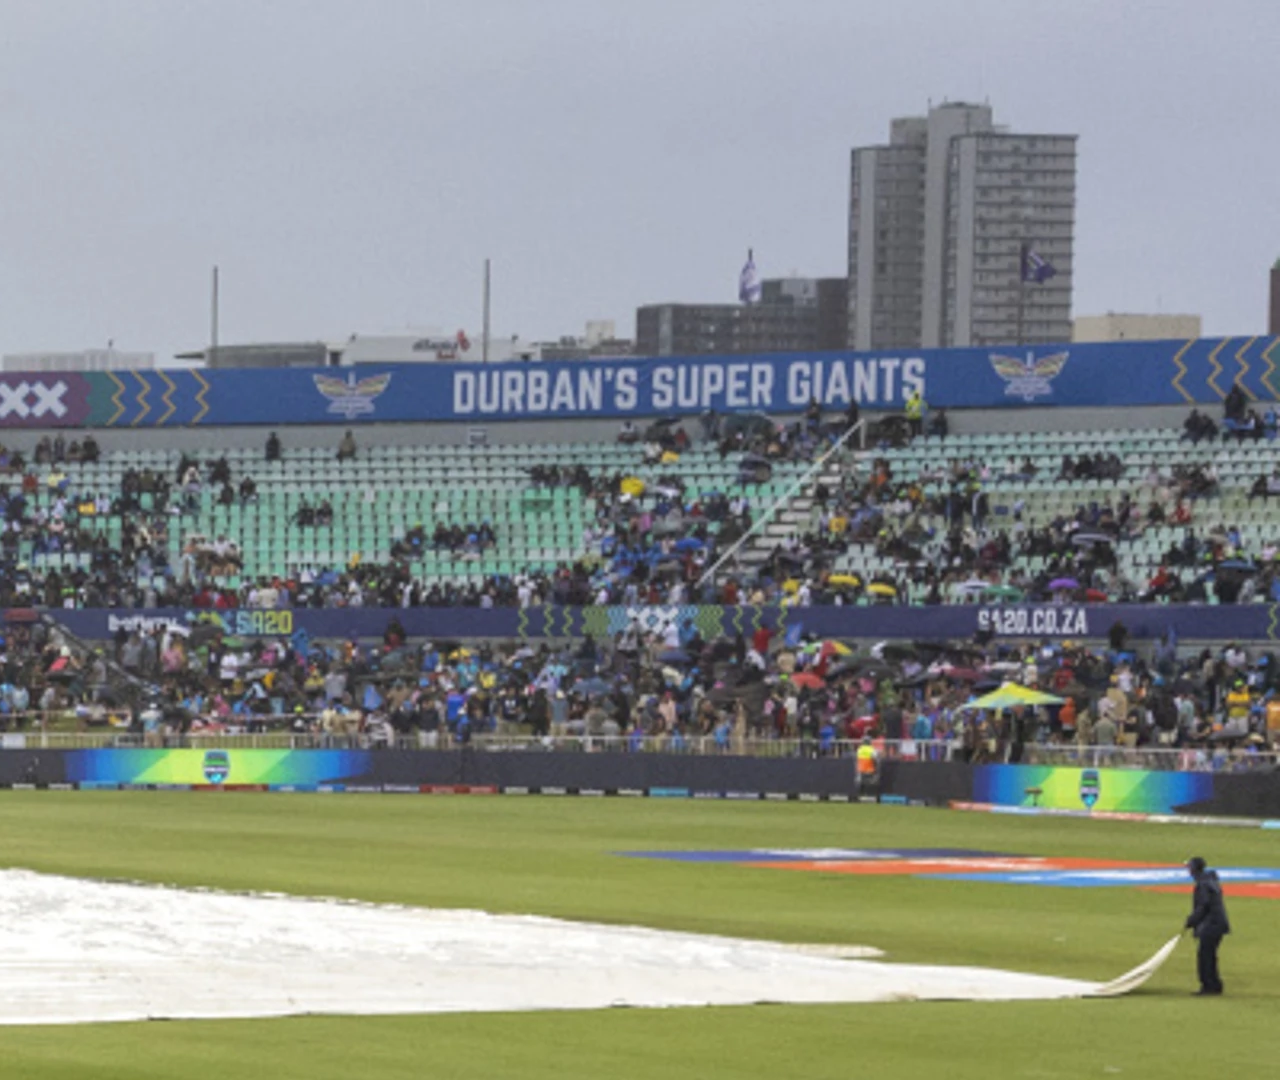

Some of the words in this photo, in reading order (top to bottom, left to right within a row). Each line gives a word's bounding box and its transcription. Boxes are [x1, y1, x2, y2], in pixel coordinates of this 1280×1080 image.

[453, 367, 638, 414] DURBAN'S
[651, 363, 774, 409] SUPER
[786, 357, 926, 405] GIANTS
[236, 611, 292, 635] SA20
[978, 608, 1088, 635] SA20.CO.ZA
